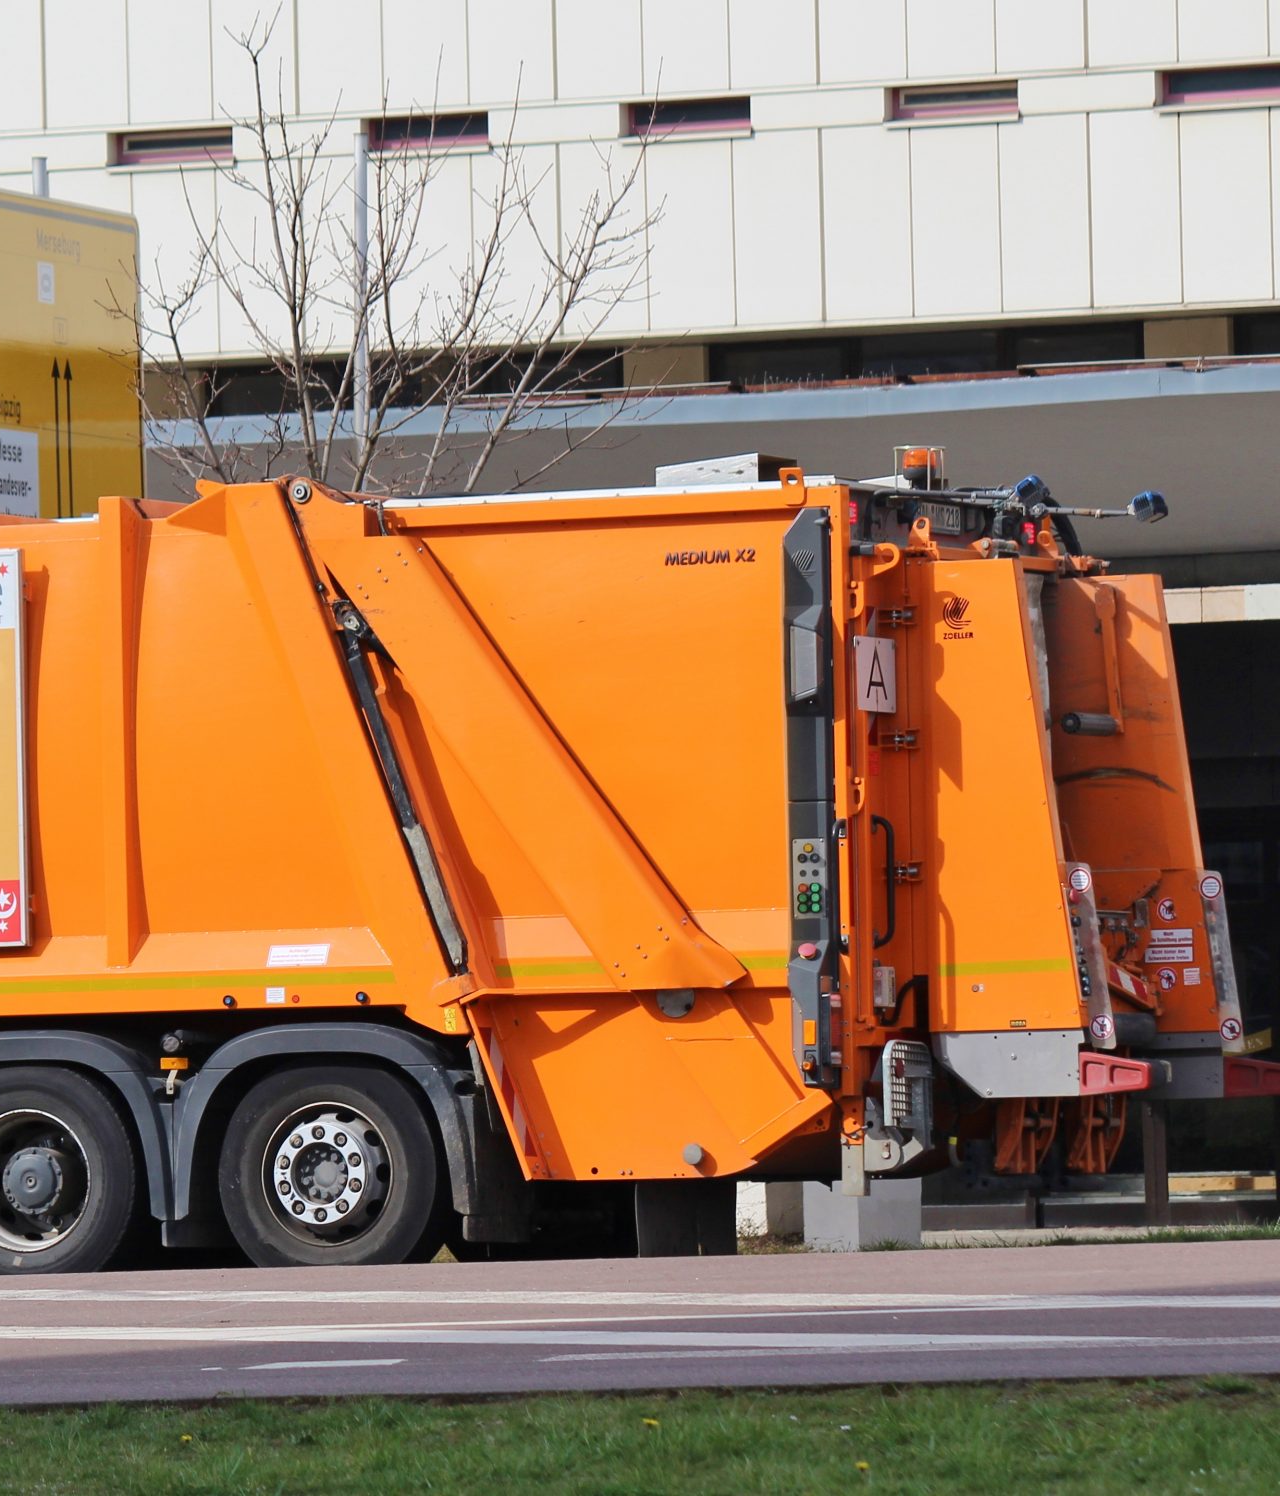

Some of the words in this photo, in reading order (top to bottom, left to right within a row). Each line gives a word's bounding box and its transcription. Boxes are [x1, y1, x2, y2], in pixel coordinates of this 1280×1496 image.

[36, 228, 80, 264] Merseburg
[665, 549, 731, 566] MEDIUM
[735, 548, 756, 563] X2
[943, 632, 974, 640] ZOELLER
[867, 646, 888, 700] A
